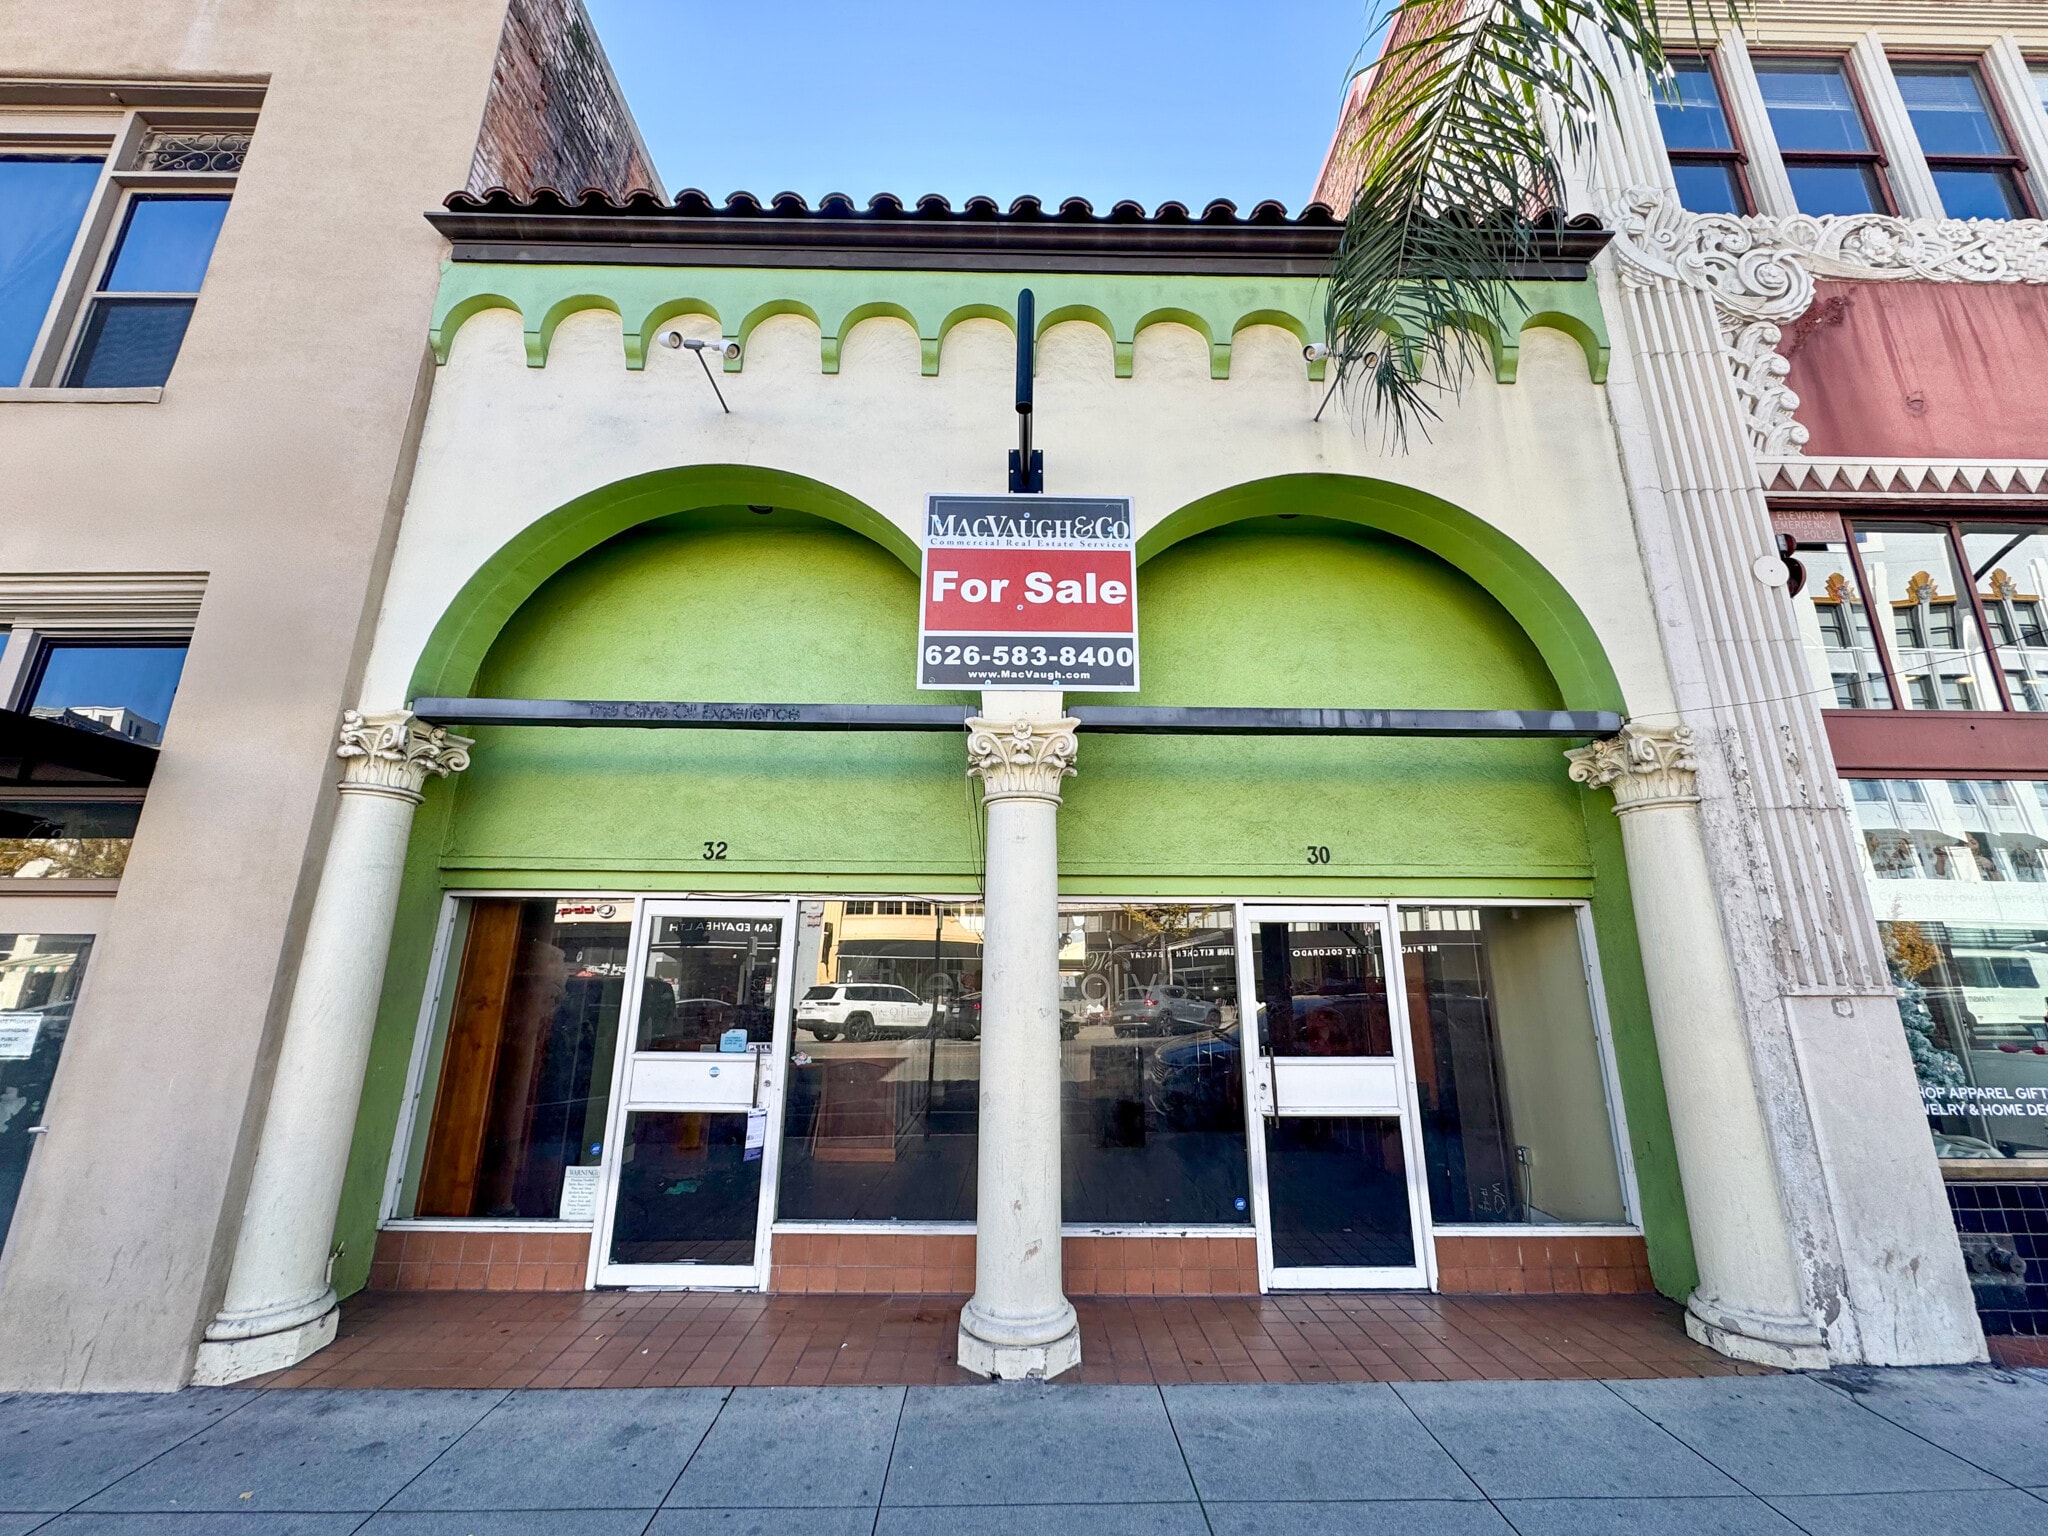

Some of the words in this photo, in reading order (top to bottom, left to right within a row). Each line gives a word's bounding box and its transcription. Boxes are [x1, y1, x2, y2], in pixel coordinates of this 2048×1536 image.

[1777, 511, 1826, 520] ELEVATOR
[1774, 520, 1832, 529] EMERGENCY
[1803, 530, 1838, 539] POLICE
[930, 538, 1000, 546] Commercial
[1006, 539, 1031, 547] Real
[1037, 540, 1074, 548] Estate
[932, 570, 1010, 603] For
[1024, 571, 1127, 604] Sale
[925, 645, 1133, 667] 626-583-8400
[968, 669, 1090, 680] www.MacVaugh.com
[588, 702, 619, 718] The
[623, 702, 668, 719] Olive
[673, 703, 697, 719] Oil
[702, 704, 801, 721] Experience
[703, 841, 727, 861] 32
[1307, 846, 1330, 864] 30
[1949, 1087, 2015, 1100] APPAREL
[2015, 1087, 2048, 1100] GIFT
[1968, 1103, 1980, 1116] &
[1980, 1103, 2026, 1116] HOME
